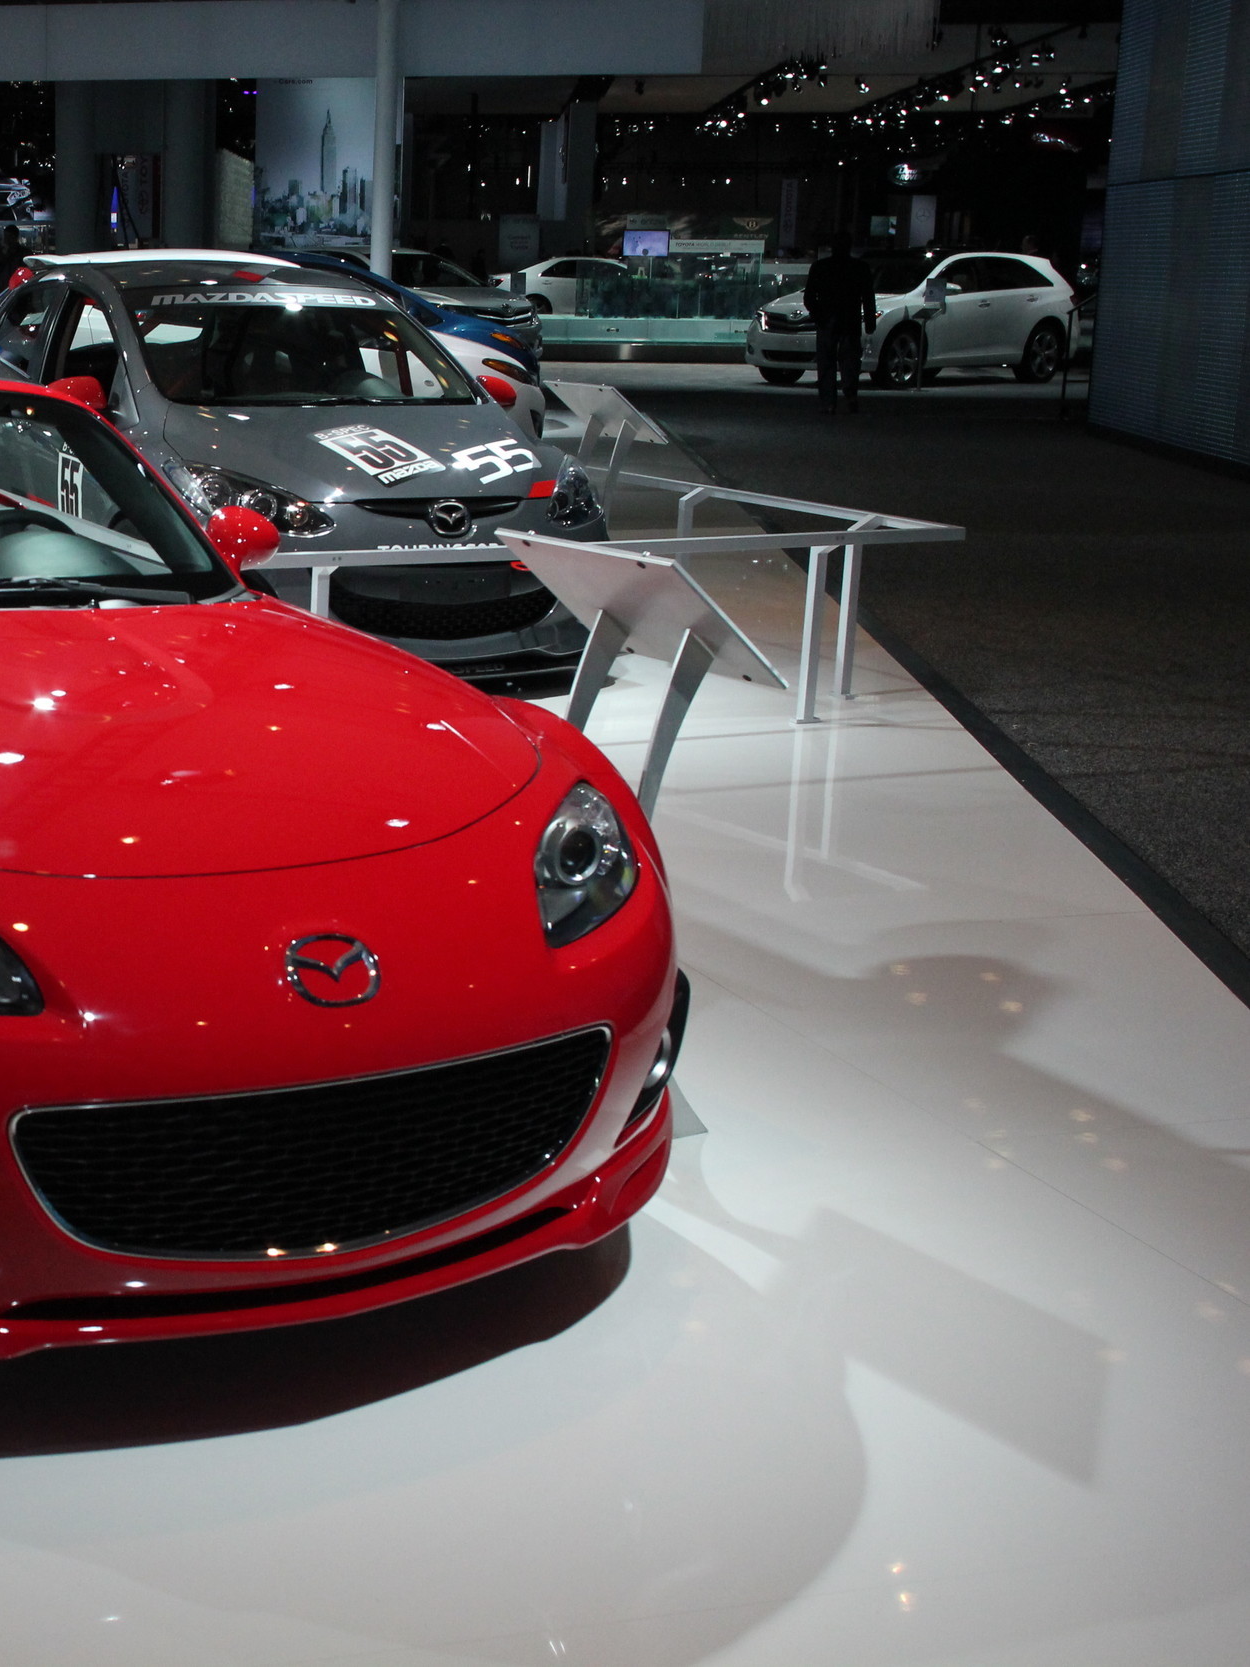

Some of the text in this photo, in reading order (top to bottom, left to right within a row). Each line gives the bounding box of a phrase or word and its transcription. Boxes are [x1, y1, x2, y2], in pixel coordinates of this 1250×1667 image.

[150, 292, 376, 306] MAZDASPEED
[313, 424, 370, 440] B-SPEC
[329, 430, 419, 470] 55
[451, 438, 536, 485] 55
[62, 456, 81, 515] 55
